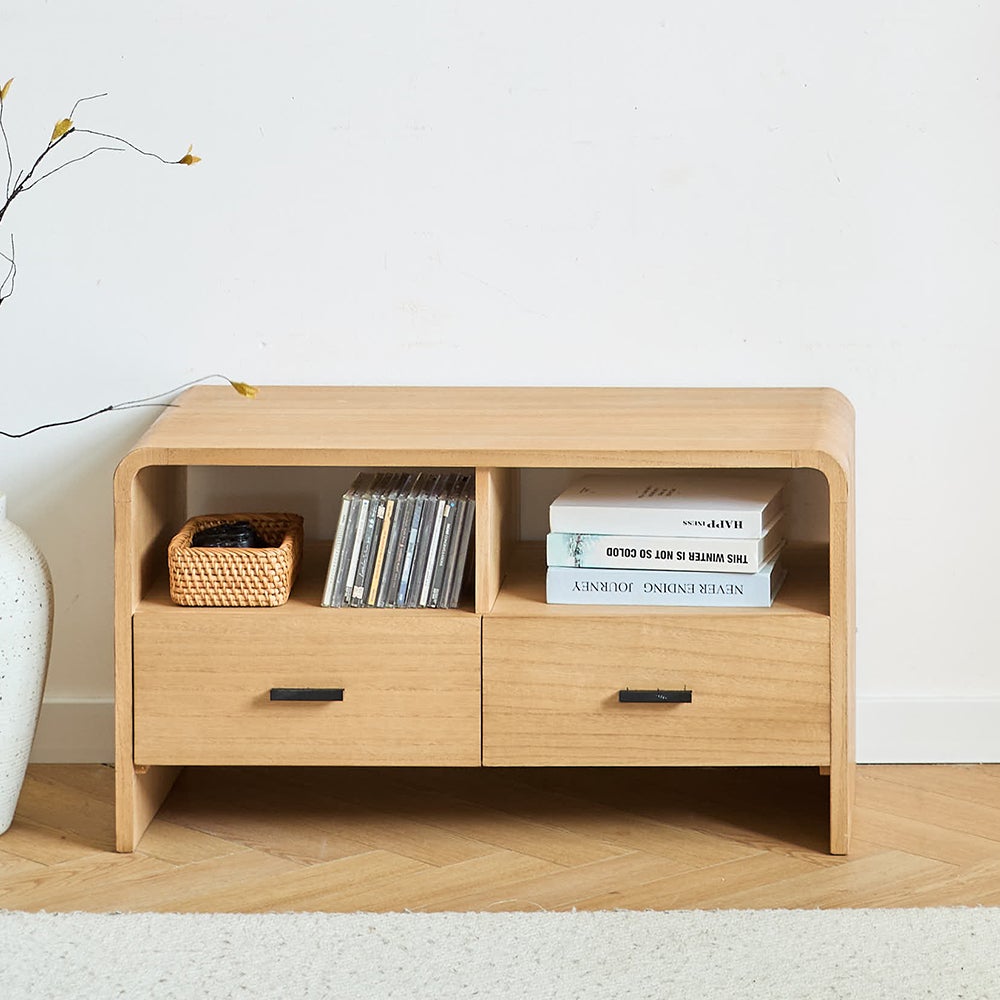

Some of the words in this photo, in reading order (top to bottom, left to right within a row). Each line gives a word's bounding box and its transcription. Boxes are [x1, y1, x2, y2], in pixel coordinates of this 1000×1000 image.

[606, 547, 637, 558] COLOD
[639, 549, 652, 559] SO
[654, 550, 673, 560] NOT
[676, 551, 686, 561] IS
[688, 552, 725, 563] WINTER
[727, 554, 748, 564] THIS
[571, 581, 634, 593] JOURNEY
[643, 582, 695, 594] ENDING
[699, 583, 744, 595] NEVER
